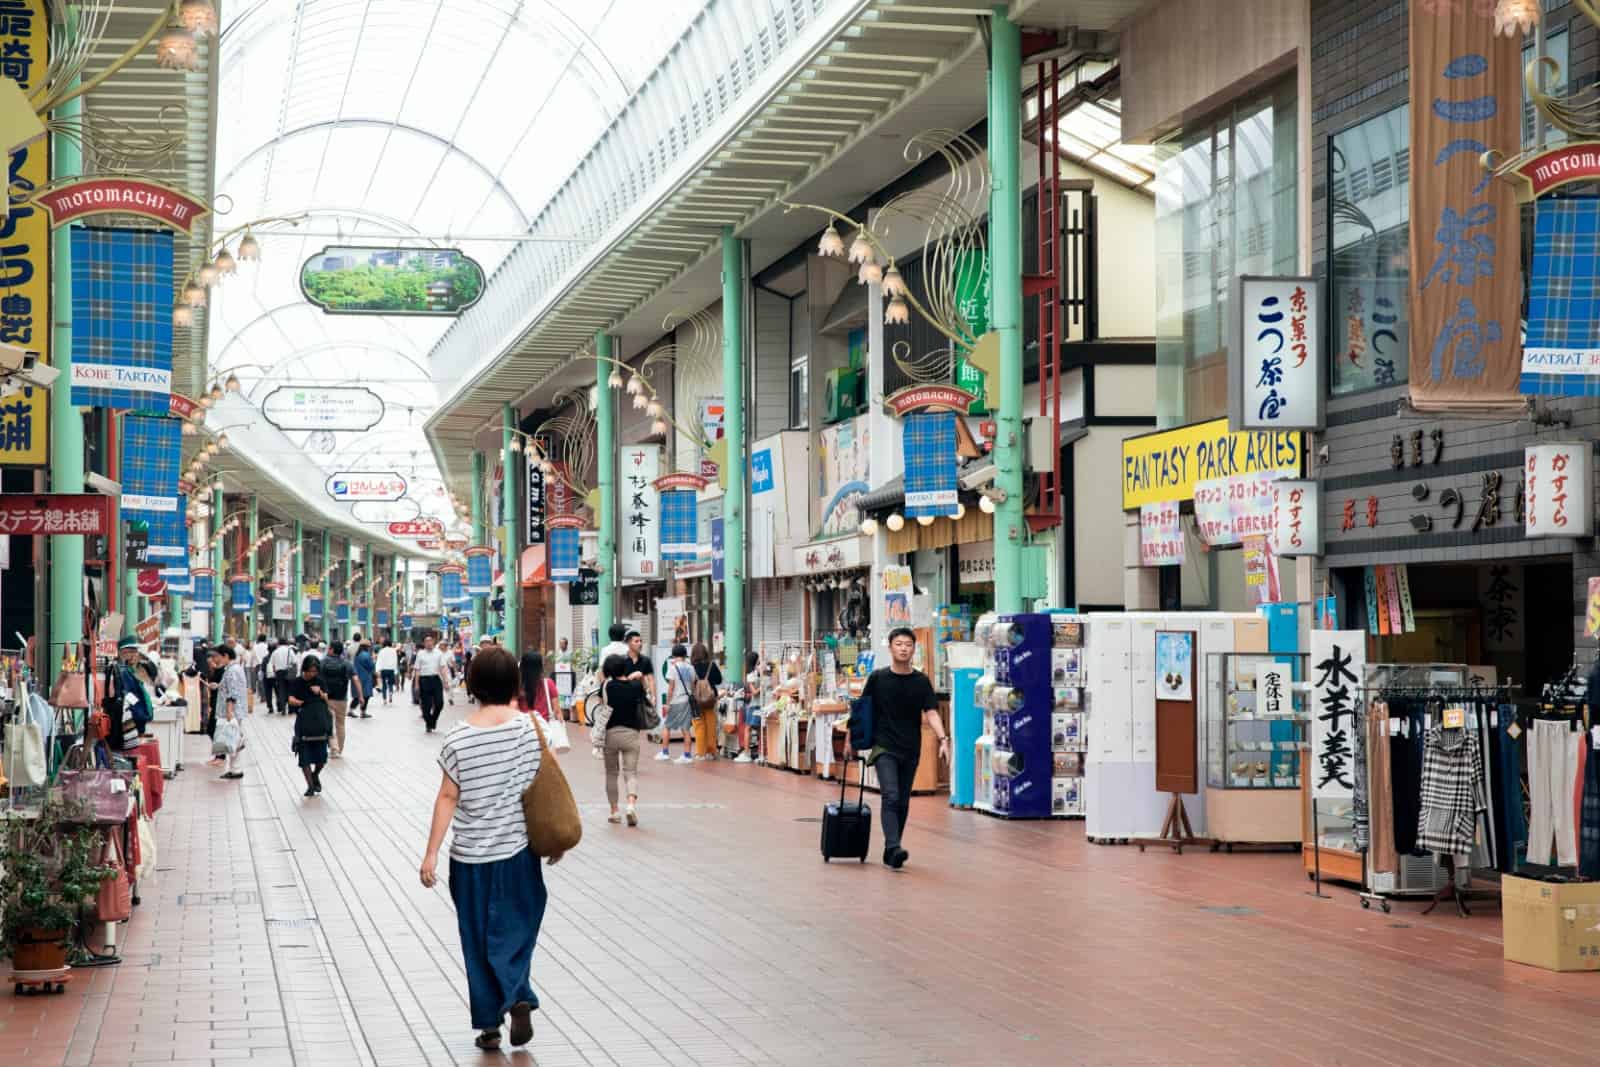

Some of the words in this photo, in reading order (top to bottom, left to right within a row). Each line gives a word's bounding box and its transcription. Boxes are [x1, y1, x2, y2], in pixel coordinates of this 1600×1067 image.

[1535, 153, 1600, 182] MOTOM
[1290, 286, 1308, 368] 京菓子
[75, 366, 111, 381] KOBE
[114, 368, 167, 386] TARTAN
[1256, 296, 1287, 421] 二つ茶屋
[1126, 445, 1190, 492] FANTASY
[1197, 433, 1237, 479] PARK
[1245, 430, 1296, 473] ARIES
[1552, 454, 1569, 528] かすてら
[1290, 487, 1304, 547] かすてら
[1265, 671, 1283, 712] 定休日
